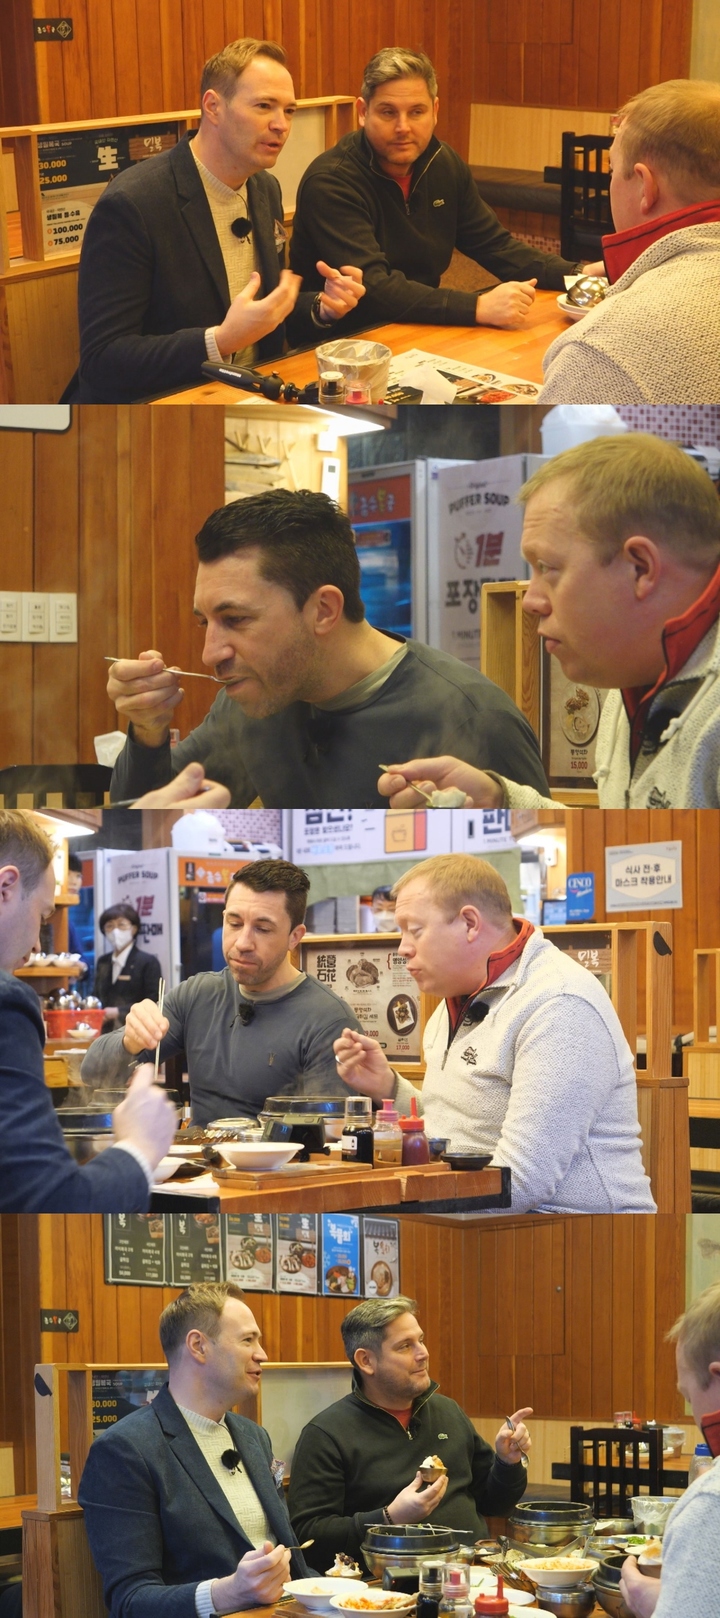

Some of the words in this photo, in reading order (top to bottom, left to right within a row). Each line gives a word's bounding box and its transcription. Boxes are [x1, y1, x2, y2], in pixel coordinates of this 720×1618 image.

[97, 145, 119, 171] 生
[448, 493, 482, 515] PUFFER
[484, 492, 511, 506] SOUP
[474, 531, 505, 568] 1분
[117, 871, 140, 885] PUFFER
[141, 870, 158, 879] SOUP
[625, 865, 641, 875] 식사
[615, 877, 638, 887] 마스크
[640, 875, 672, 886] 착용안내
